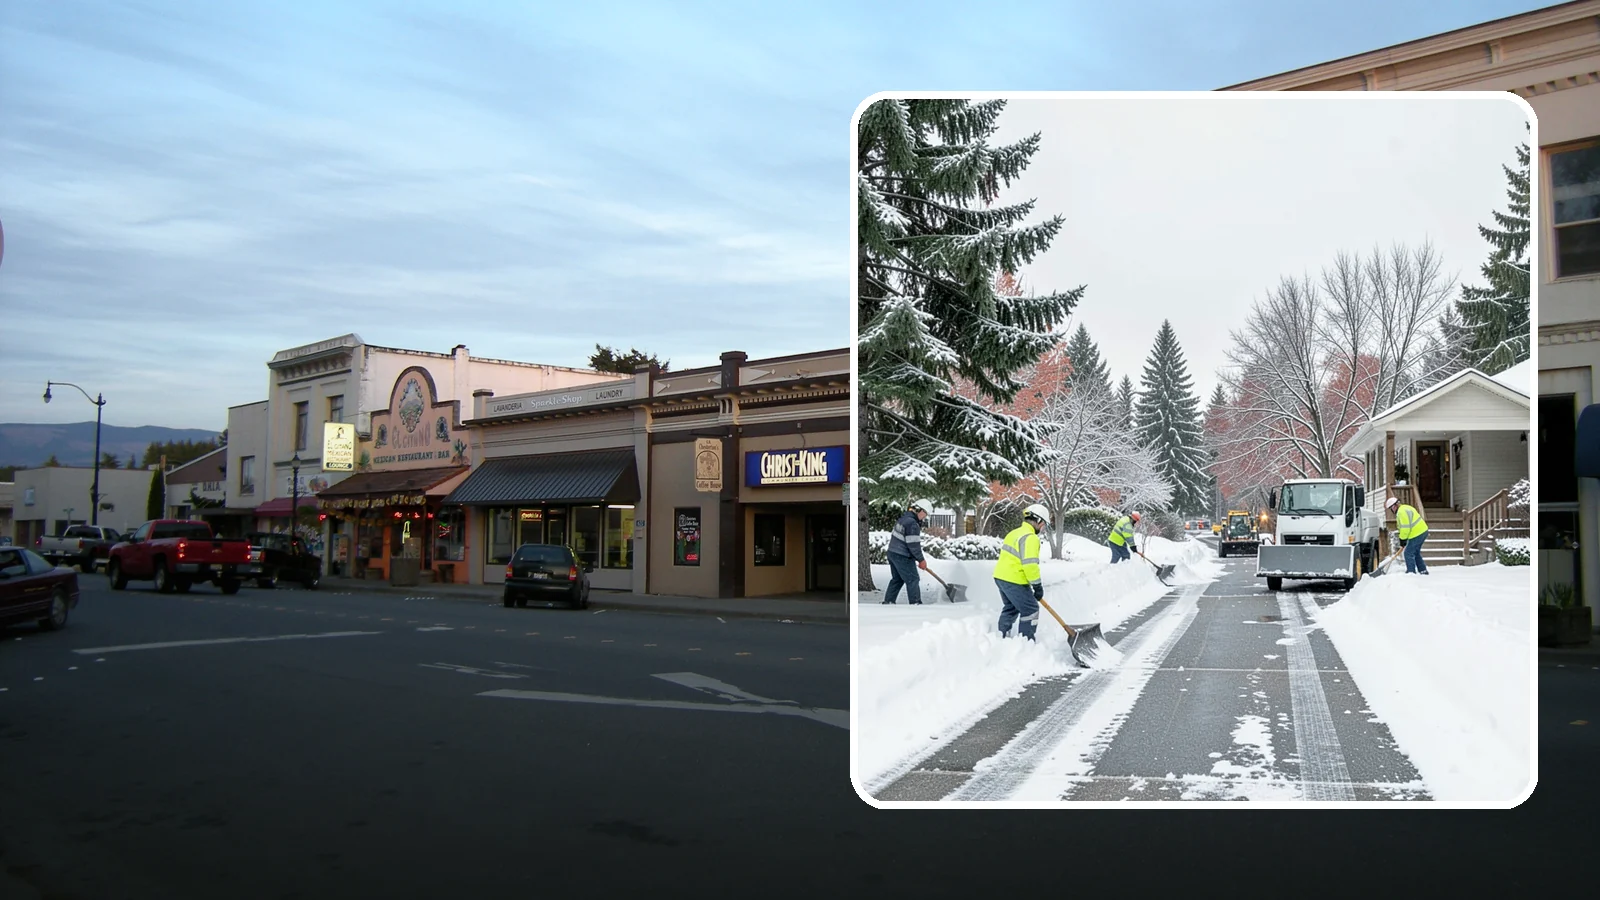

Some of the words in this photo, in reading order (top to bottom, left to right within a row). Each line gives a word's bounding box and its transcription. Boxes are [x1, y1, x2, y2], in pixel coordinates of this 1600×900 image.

[531, 398, 560, 409] Sparkle
[562, 394, 583, 405] Shop
[595, 389, 623, 400] LAUNDRY
[493, 402, 522, 412] LAVANDERIA
[373, 456, 396, 464] MEXICAN
[397, 452, 433, 462] RESTAURANT
[438, 450, 450, 459] BAR
[799, 450, 827, 476] KING
[761, 452, 797, 478] CHRIST
